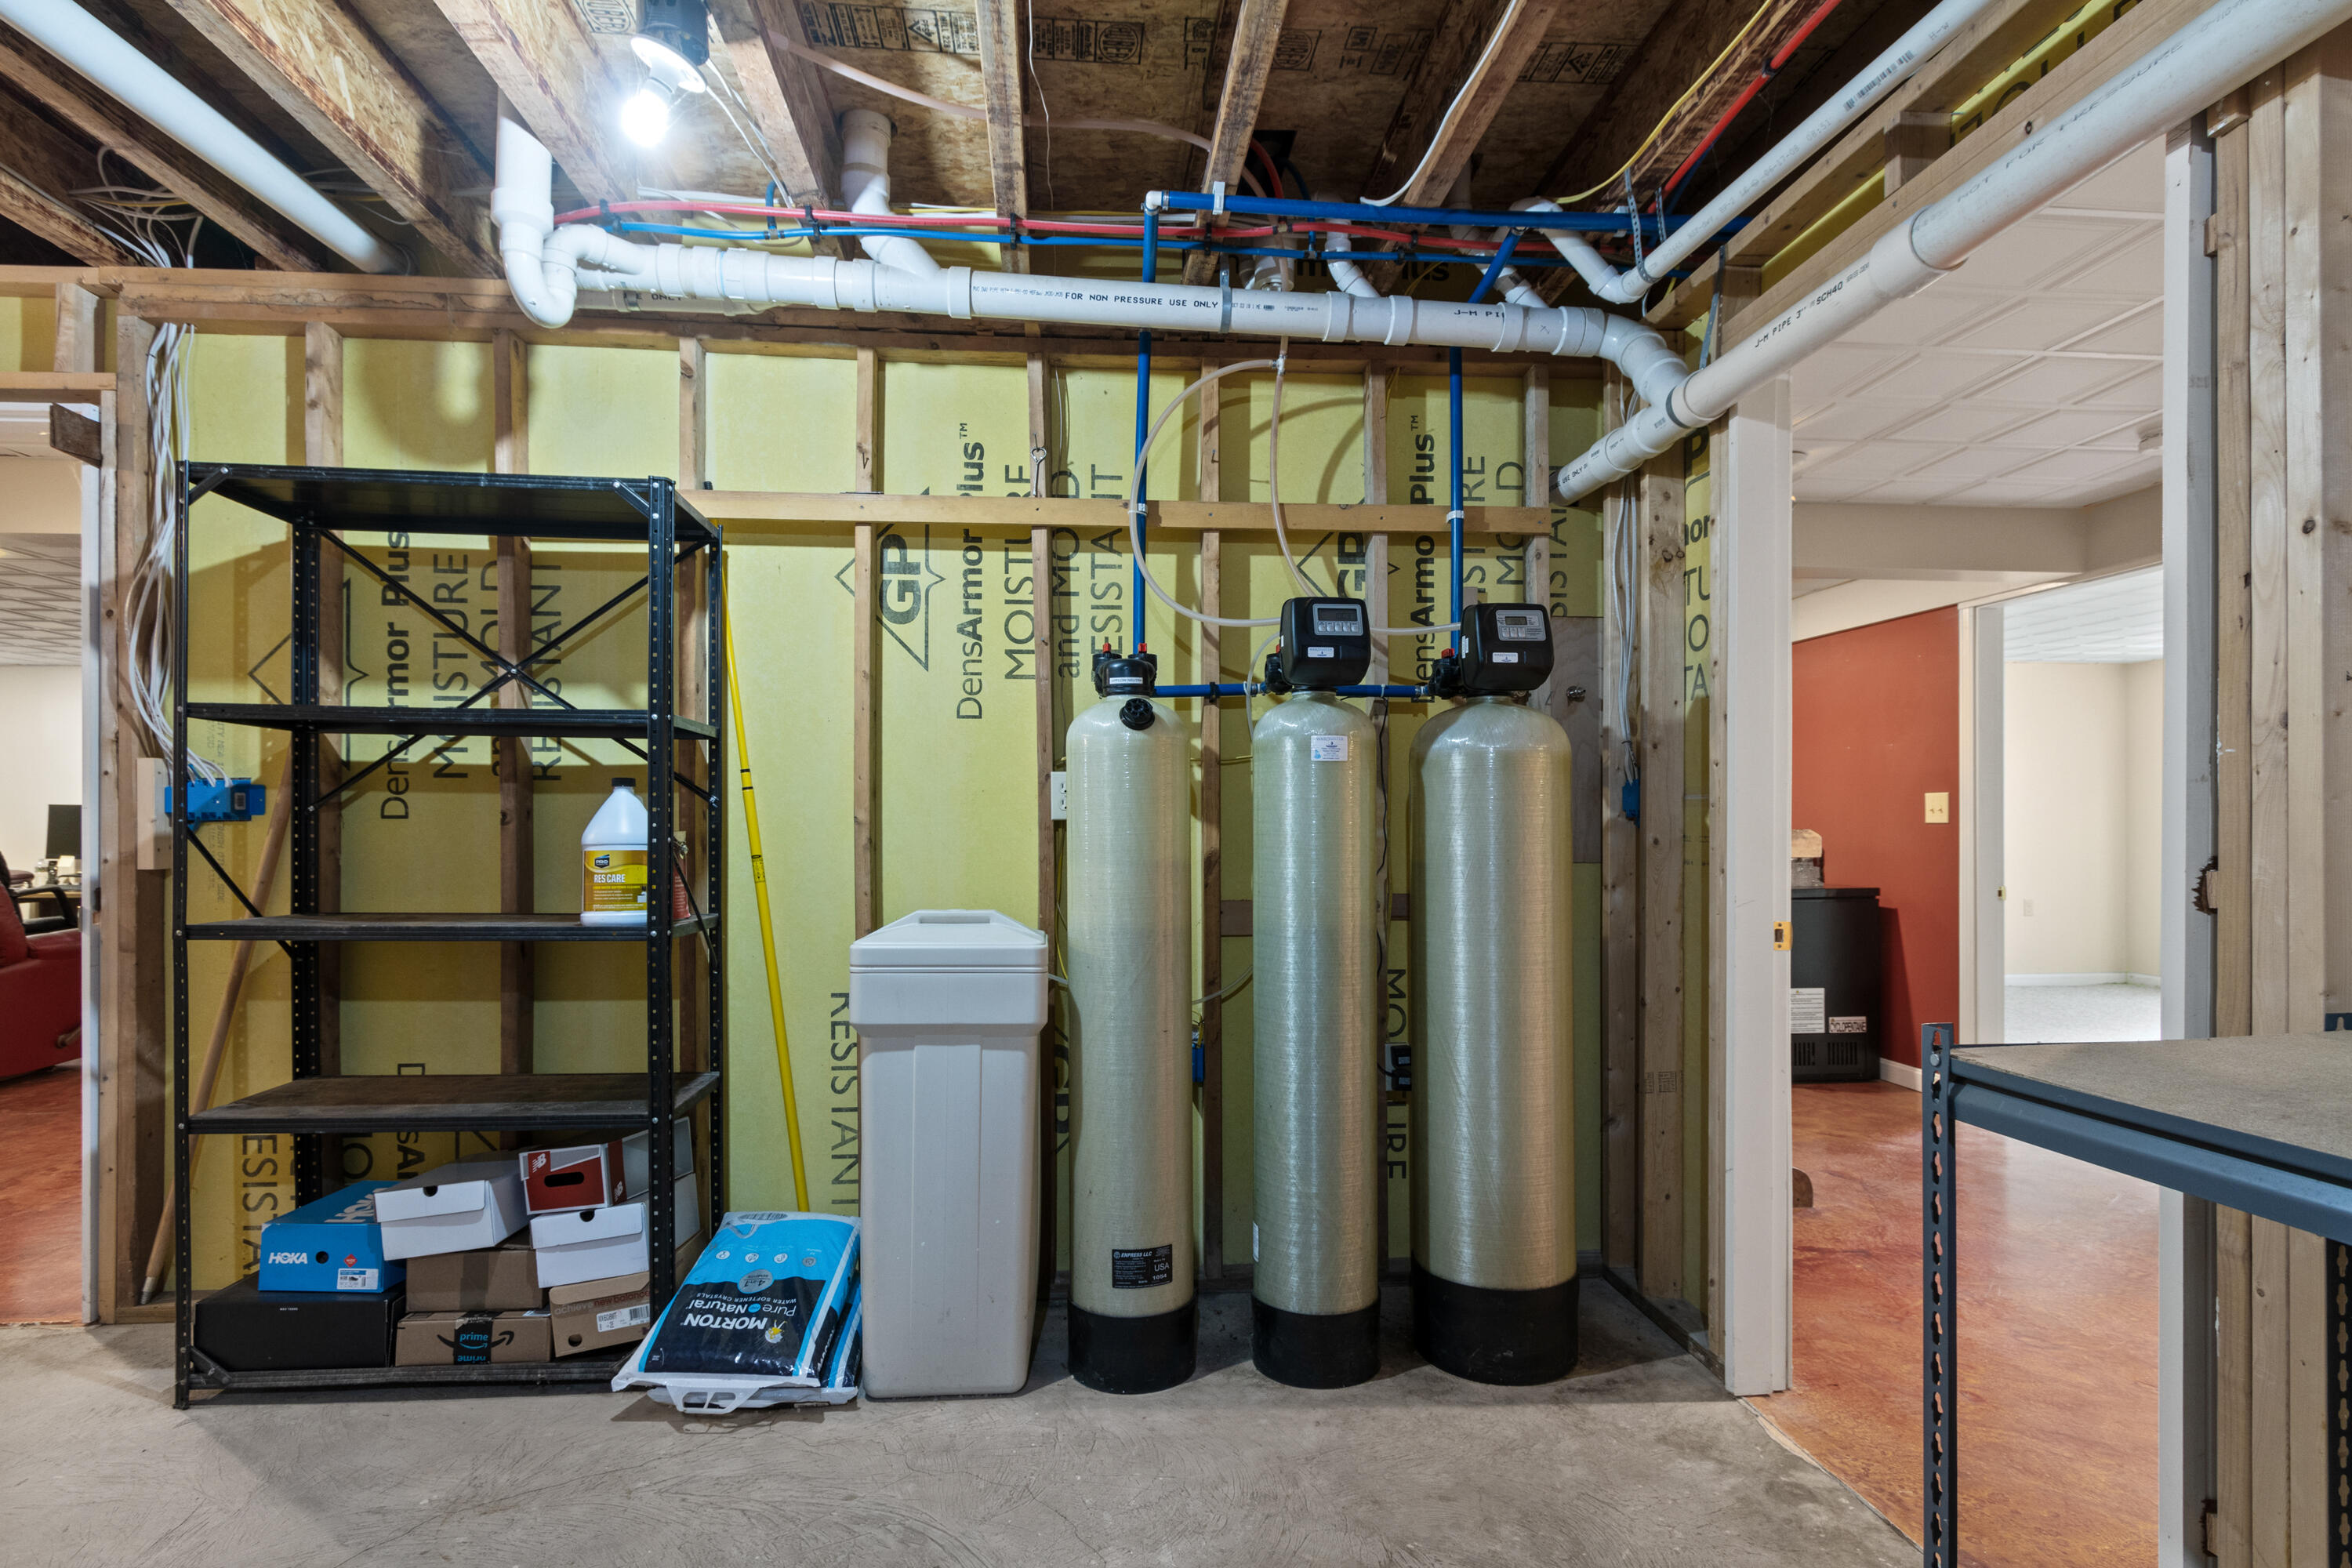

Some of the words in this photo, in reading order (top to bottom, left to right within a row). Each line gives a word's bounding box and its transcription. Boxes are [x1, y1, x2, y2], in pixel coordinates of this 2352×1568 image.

[1065, 292, 1083, 300] FOR
[1089, 294, 1109, 303] NON
[1114, 295, 1163, 306] PRESSURE
[1169, 298, 1187, 307] USE
[1193, 300, 1219, 309] ONLY
[1755, 333, 1769, 348] J-M
[1772, 316, 1792, 336] PIPE
[1816, 280, 1844, 306] SCH40
[1562, 472, 1571, 484] USE
[1571, 467, 1583, 478] ONLY
[1051, 470, 1080, 597] MOD
[878, 533, 922, 625] GP
[956, 528, 984, 719] DensArmor
[593, 873, 607, 884] RES
[607, 873, 626, 884] CARE
[267, 1252, 308, 1265] HOKA
[1153, 1262, 1171, 1272] USA
[696, 1292, 732, 1303] CRYSTALS
[554, 1302, 593, 1316] achieve
[688, 1299, 746, 1316] Natural
[762, 1304, 797, 1317] Pure
[683, 1312, 768, 1330] MORTON
[459, 1332, 489, 1342] prime
